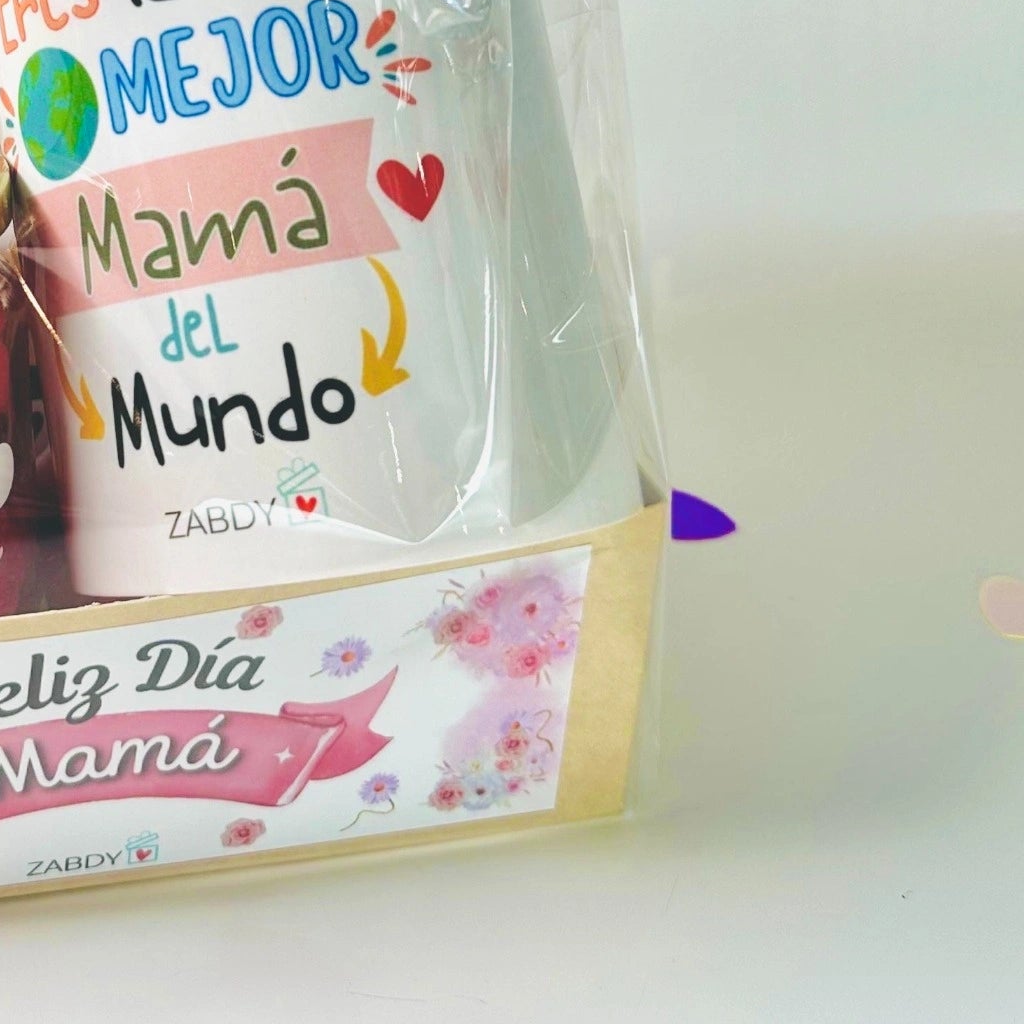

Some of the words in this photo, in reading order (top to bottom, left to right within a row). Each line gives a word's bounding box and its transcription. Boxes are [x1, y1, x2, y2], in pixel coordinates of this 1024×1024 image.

[78, 146, 330, 295] Mamá
[111, 342, 356, 469] Mundo
[164, 497, 276, 540] ZABDY
[135, 636, 266, 692] Día
[26, 850, 123, 877] ZABDY
